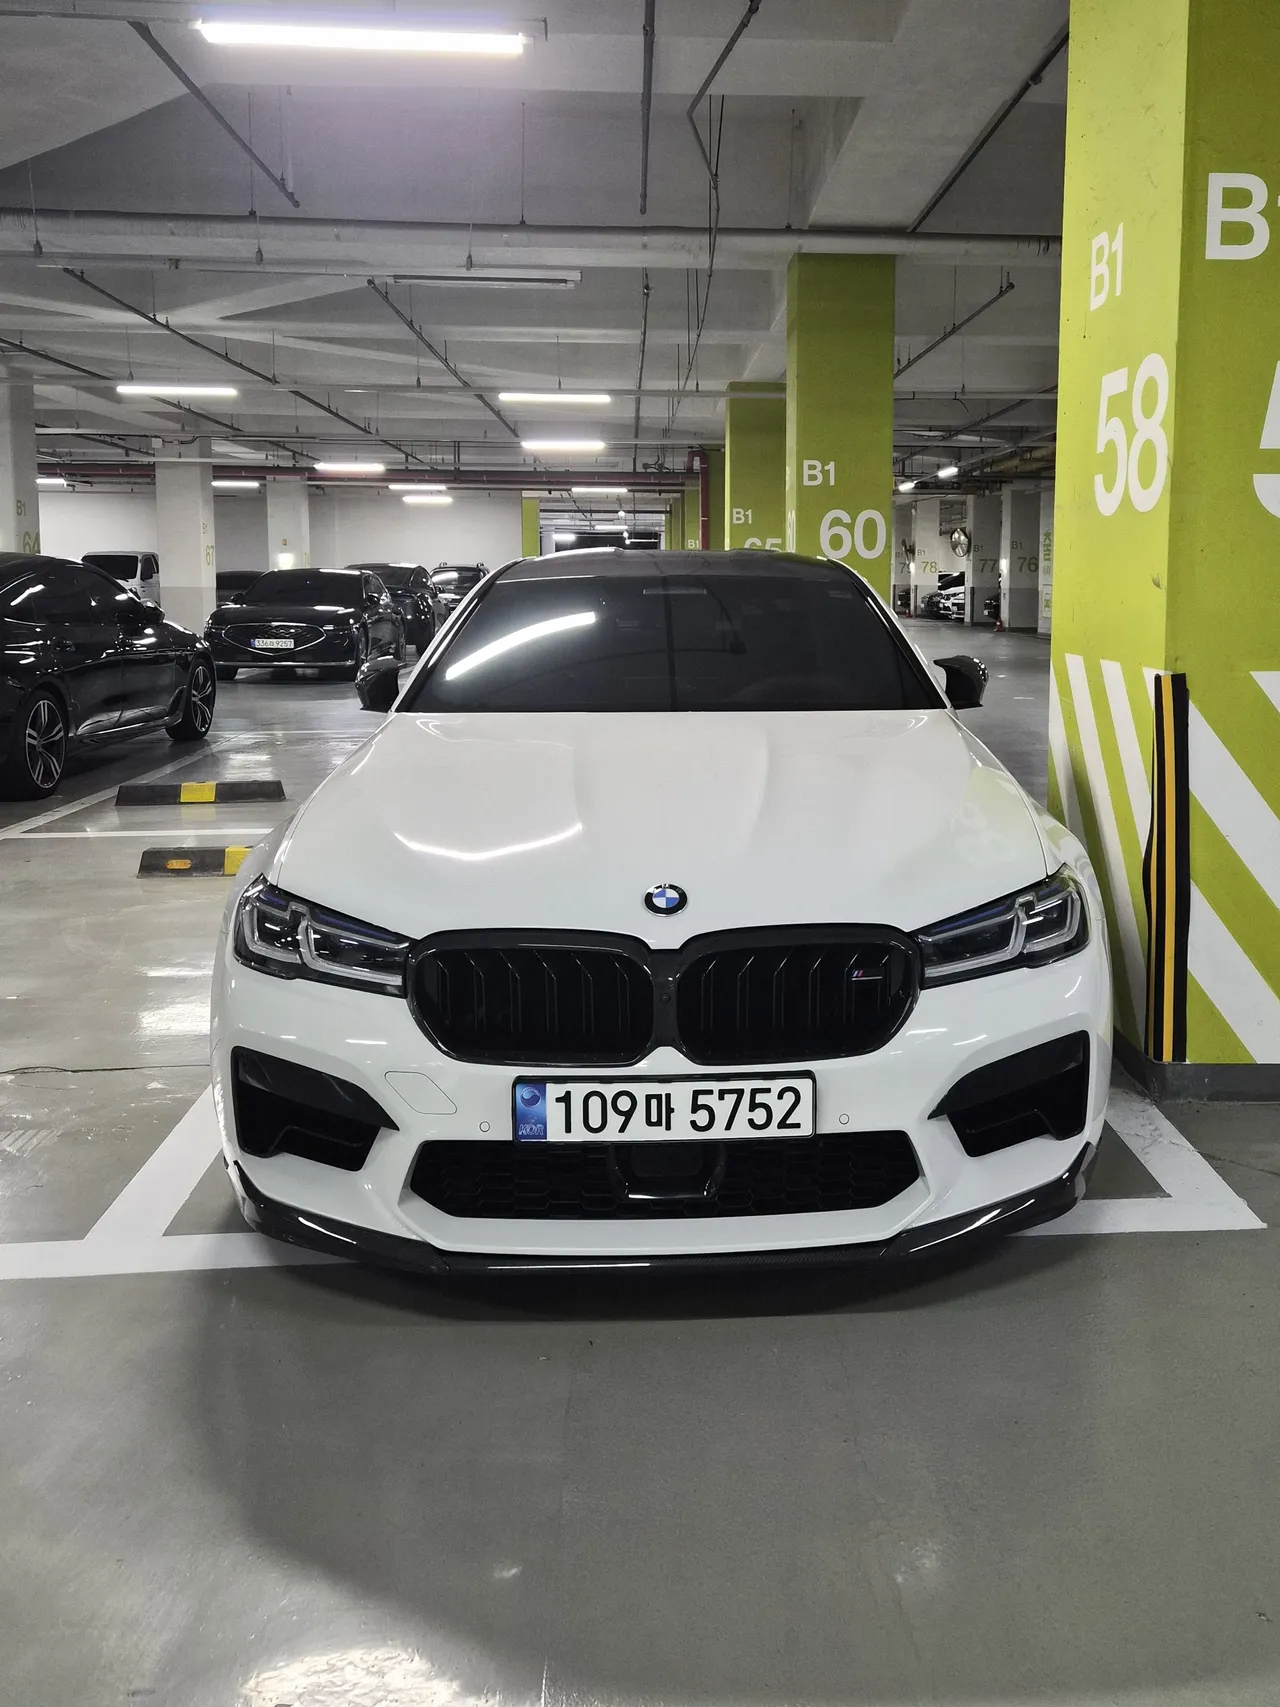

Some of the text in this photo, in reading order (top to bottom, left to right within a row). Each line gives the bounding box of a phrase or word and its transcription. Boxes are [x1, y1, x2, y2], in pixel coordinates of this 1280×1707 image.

[1204, 171, 1280, 260] B
[1089, 222, 1124, 312] B1
[1094, 353, 1169, 517] 58
[802, 459, 836, 486] B1
[15, 499, 27, 517] B1
[732, 507, 753, 525] B1
[819, 508, 888, 560] 60
[916, 548, 926, 556] B1
[973, 544, 984, 553] B1
[1011, 540, 1023, 550] B1
[921, 561, 938, 574] 78
[979, 558, 998, 574] 77
[1017, 556, 1039, 573] 76
[555, 1085, 802, 1134] 109마 5752
[518, 1123, 545, 1136] KOR
